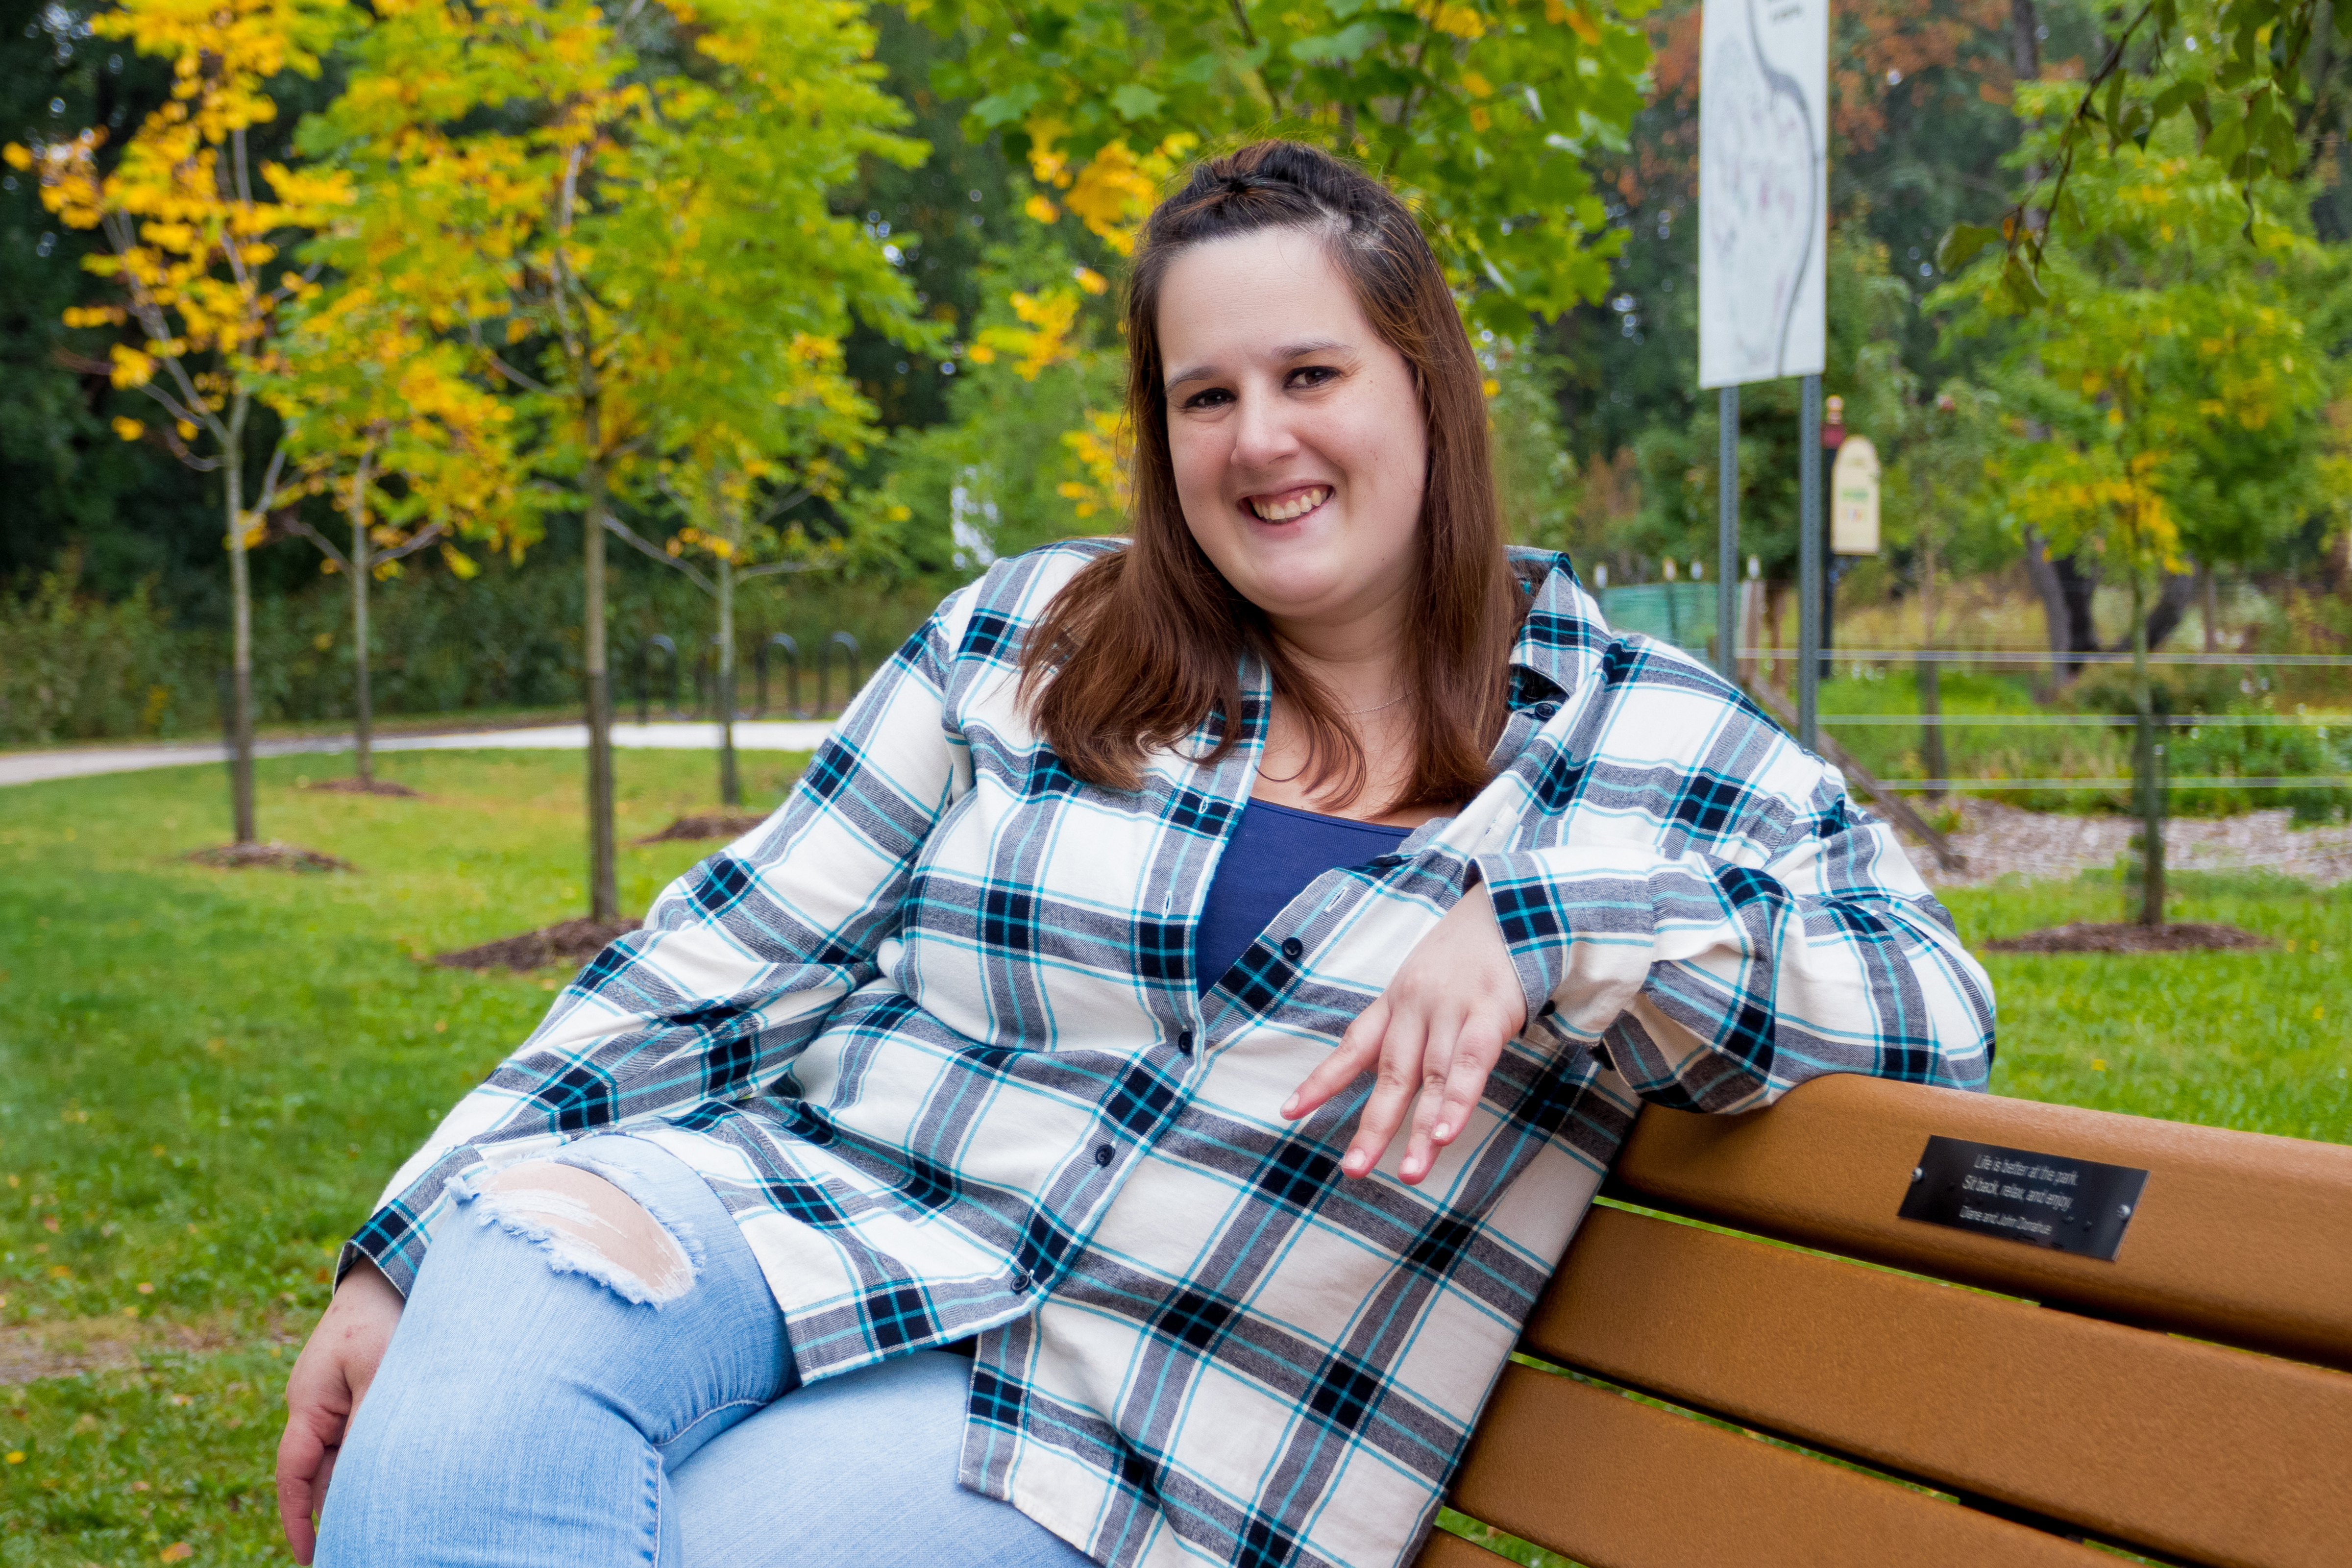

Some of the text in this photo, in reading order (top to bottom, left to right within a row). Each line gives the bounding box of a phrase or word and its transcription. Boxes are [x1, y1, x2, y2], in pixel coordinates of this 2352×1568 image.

[1974, 1153, 1992, 1171] Life
[1992, 1157, 2002, 1172] is
[2001, 1158, 2029, 1176] better
[2028, 1165, 2041, 1179] at
[2038, 1165, 2055, 1181] the
[1962, 1175, 1978, 1190] Sit
[2026, 1188, 2048, 1203] and
[1983, 1212, 2000, 1225] and
